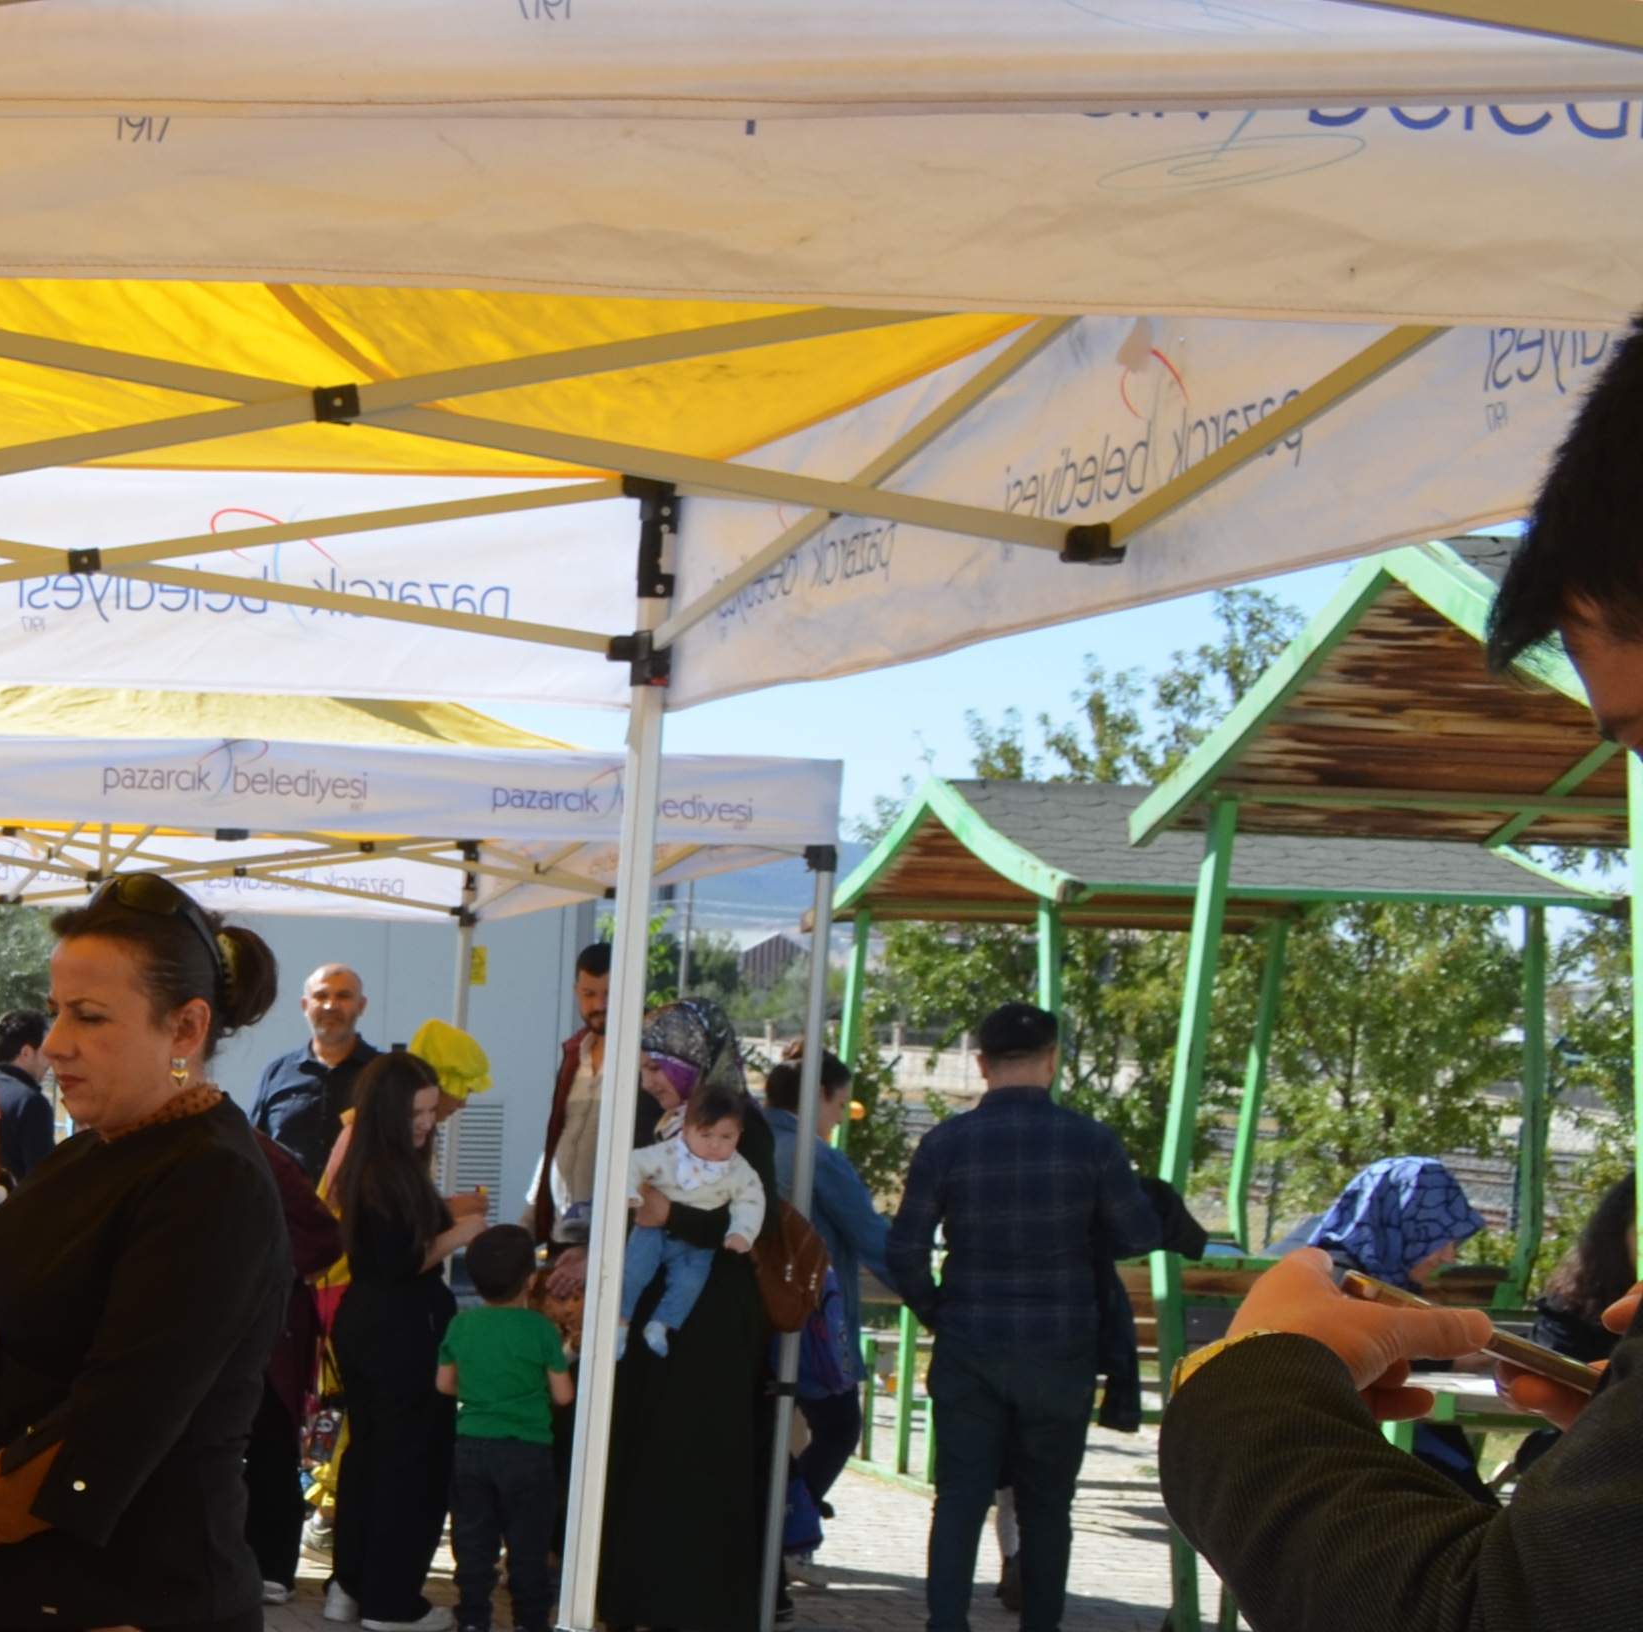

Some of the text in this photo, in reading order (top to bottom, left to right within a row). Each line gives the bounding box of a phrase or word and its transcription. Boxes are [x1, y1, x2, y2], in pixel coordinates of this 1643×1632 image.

[103, 764, 368, 804] pazarcık belediyesi
[491, 786, 600, 813] pazarcık
